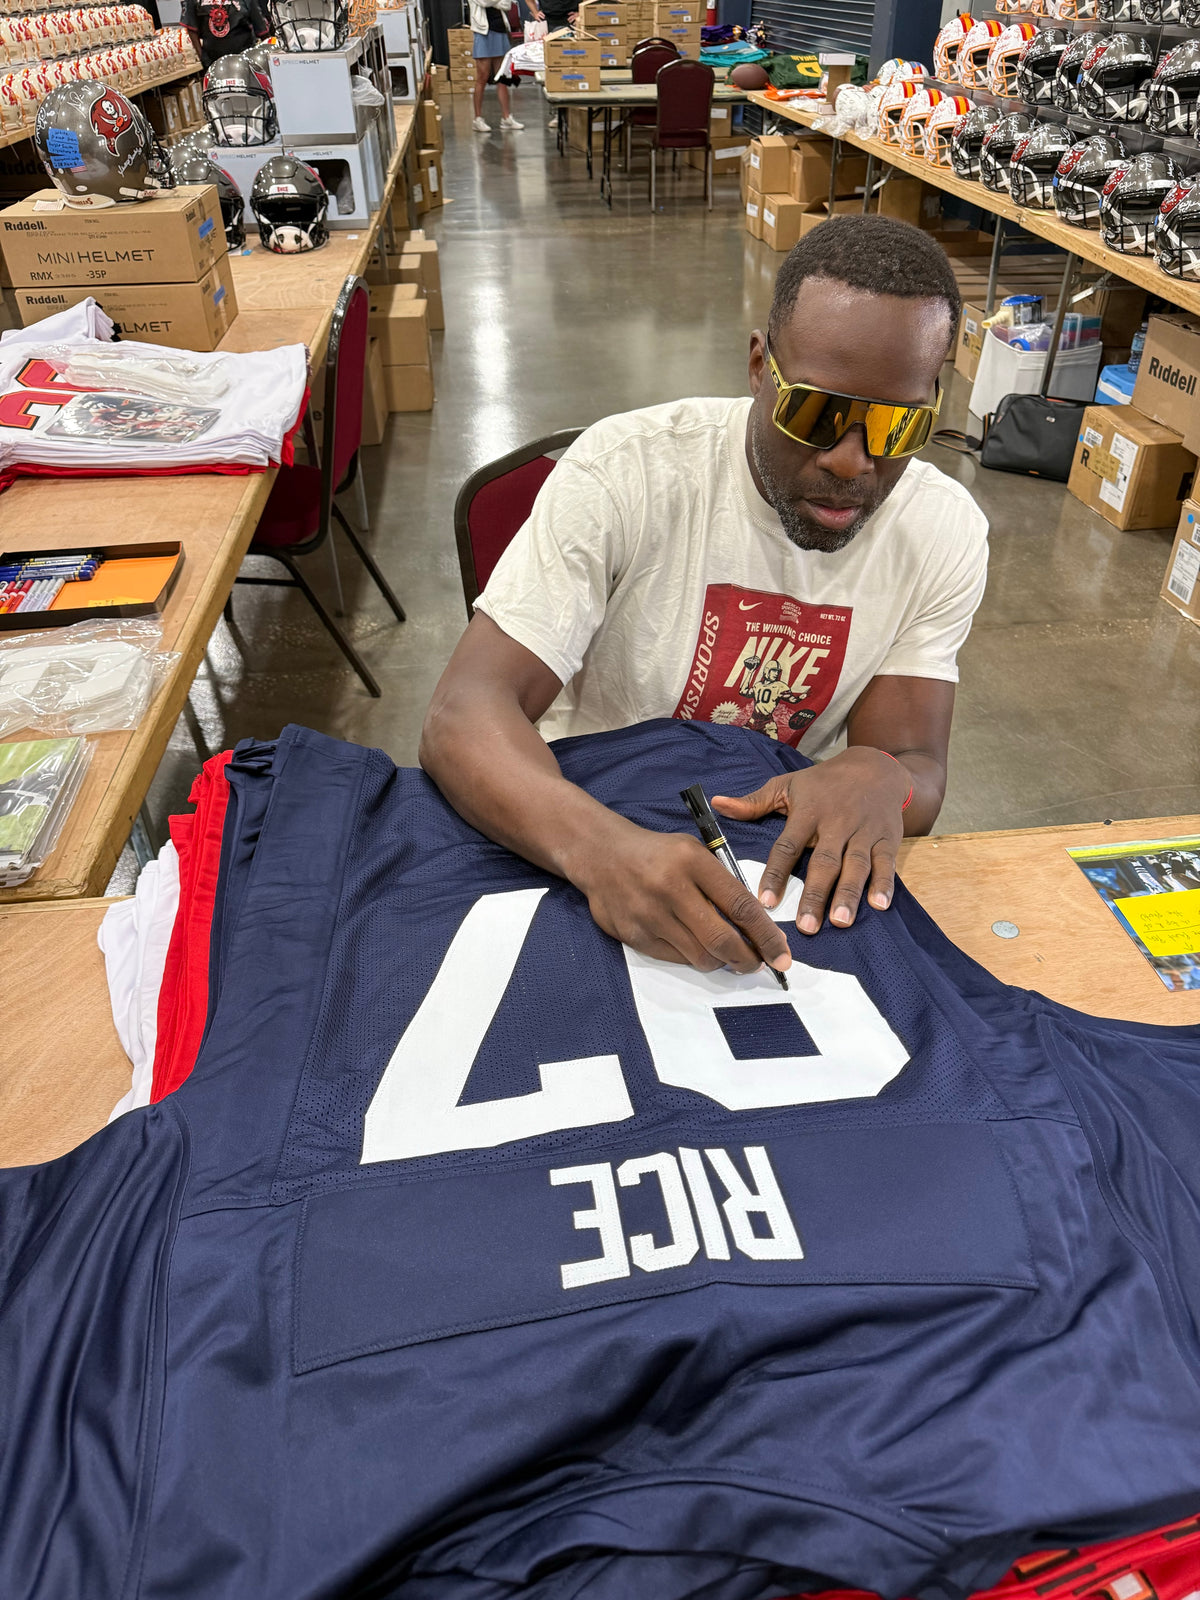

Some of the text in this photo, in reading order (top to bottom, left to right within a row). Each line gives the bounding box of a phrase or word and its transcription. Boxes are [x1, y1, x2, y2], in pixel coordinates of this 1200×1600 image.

[30, 272, 53, 281] RMX
[86, 270, 107, 279] -35P
[1148, 356, 1197, 396] Riddell
[745, 621, 832, 645] THE WINNING CHOICE
[723, 636, 830, 694] NIKE
[757, 688, 771, 704] 10
[358, 858, 911, 1165] 87
[550, 1145, 805, 1290] RICE
